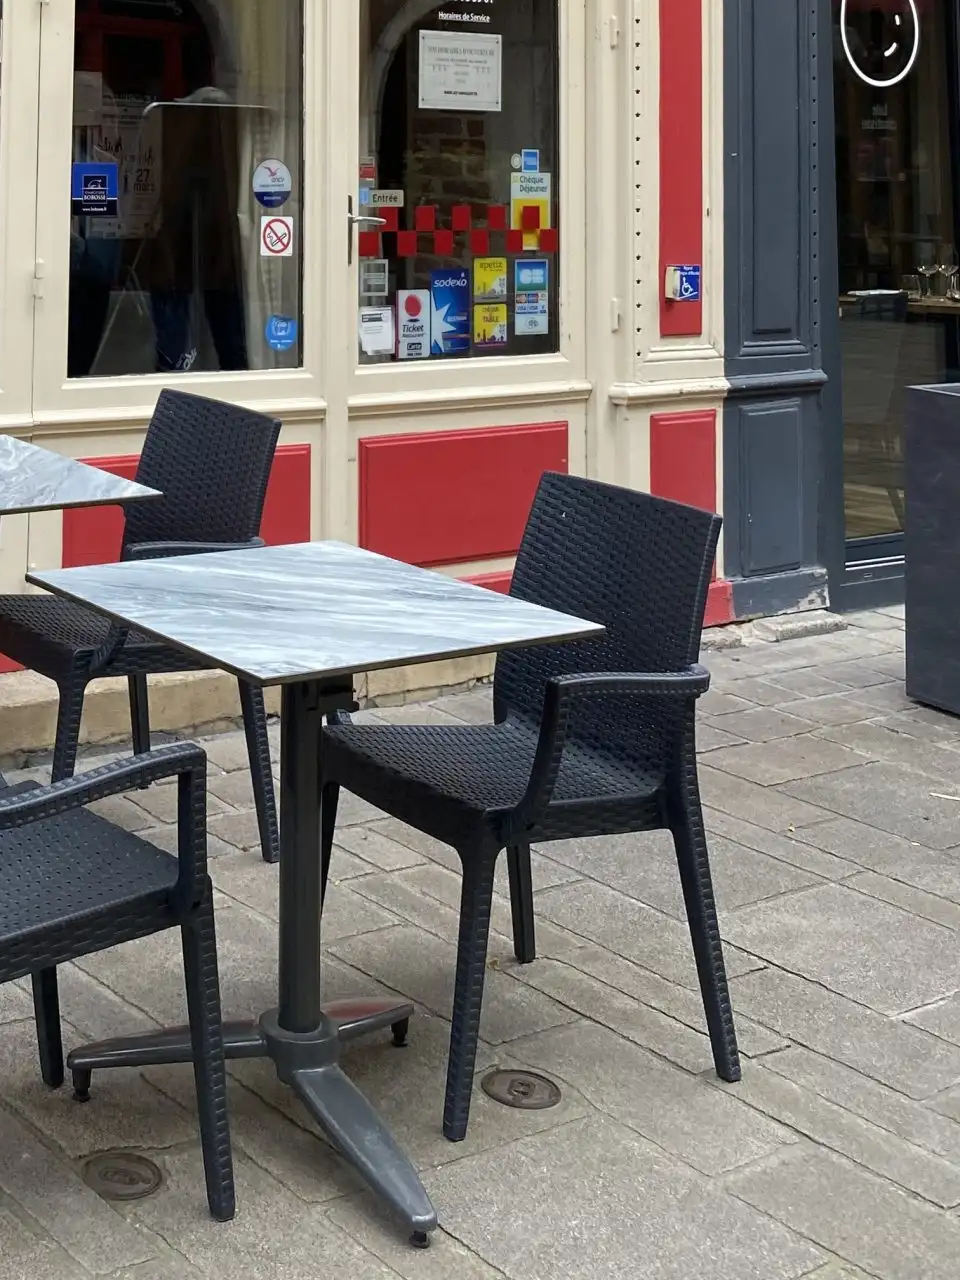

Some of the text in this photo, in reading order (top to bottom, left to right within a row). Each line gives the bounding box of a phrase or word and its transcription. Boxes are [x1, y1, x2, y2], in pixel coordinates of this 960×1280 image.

[438, 11, 490, 23] Horaires de Service
[520, 175, 544, 185] Chèque
[520, 184, 548, 194] Déjeuner
[372, 193, 398, 204] Entrée
[432, 276, 468, 288] sodexo
[401, 323, 425, 333] Ticket
